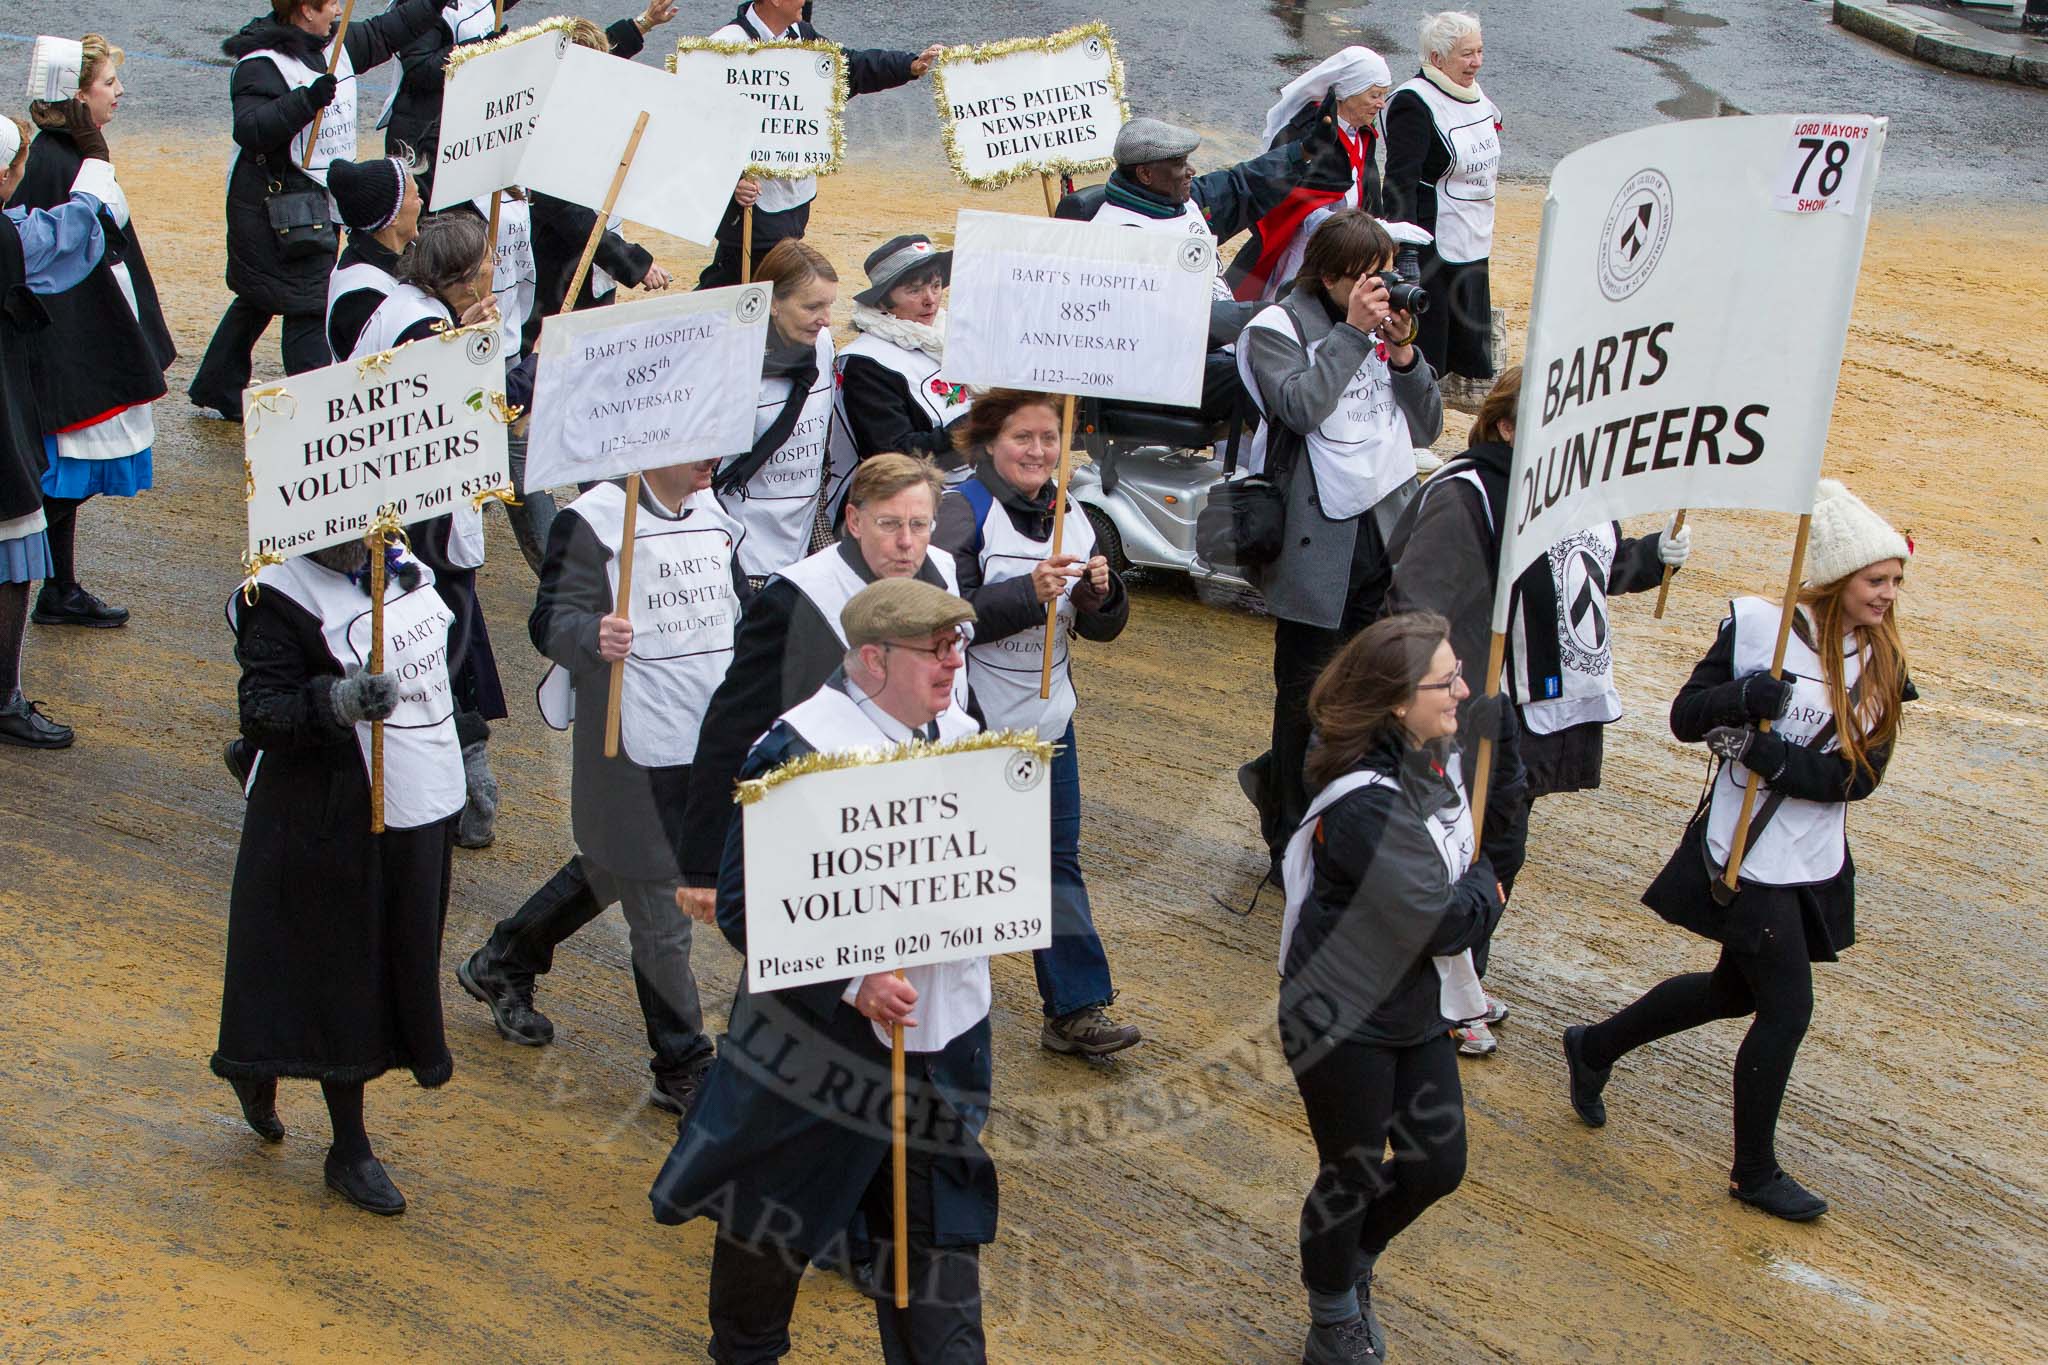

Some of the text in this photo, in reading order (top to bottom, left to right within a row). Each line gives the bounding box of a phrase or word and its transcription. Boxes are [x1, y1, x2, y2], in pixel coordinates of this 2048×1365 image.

[727, 68, 790, 86] BART'S
[485, 87, 535, 120] BART'S
[954, 79, 1108, 120] BART'S PATIENTS
[982, 103, 1092, 137] NEWSPAPER
[1795, 123, 1869, 139] LORD MAYOR'S
[442, 121, 523, 164] SOUVENIR
[750, 150, 831, 164] 020 7601 8339
[987, 124, 1097, 158] DELIVERIES
[1791, 138, 1850, 198] 78
[1797, 199, 1827, 212] SHOW
[1011, 267, 1161, 292] BART'S HOSPITAL
[1060, 298, 1111, 323] 885th
[585, 324, 715, 361] BART'S HOSPITAL
[1019, 331, 1141, 352] ANNIVERSARY
[625, 355, 671, 388] 885th
[1541, 321, 1675, 428] BARTS
[327, 373, 429, 424] BART'S
[588, 387, 695, 420] ANNIVERSARY
[302, 402, 454, 467] HOSPITAL
[277, 430, 481, 508] VOLUNTEERS
[258, 526, 317, 554] Please
[325, 511, 369, 537] Ring
[415, 485, 454, 511] 7601
[461, 471, 503, 498] 8339
[658, 555, 721, 579] BART'S
[647, 583, 731, 610] HOSPITAL
[391, 610, 447, 653] BART'S
[839, 791, 959, 835] BART'S
[810, 829, 989, 881] HOSPITAL
[780, 865, 1018, 925] VOLUNTEERS
[758, 916, 1042, 979] Please Ring 020 7601 8339
